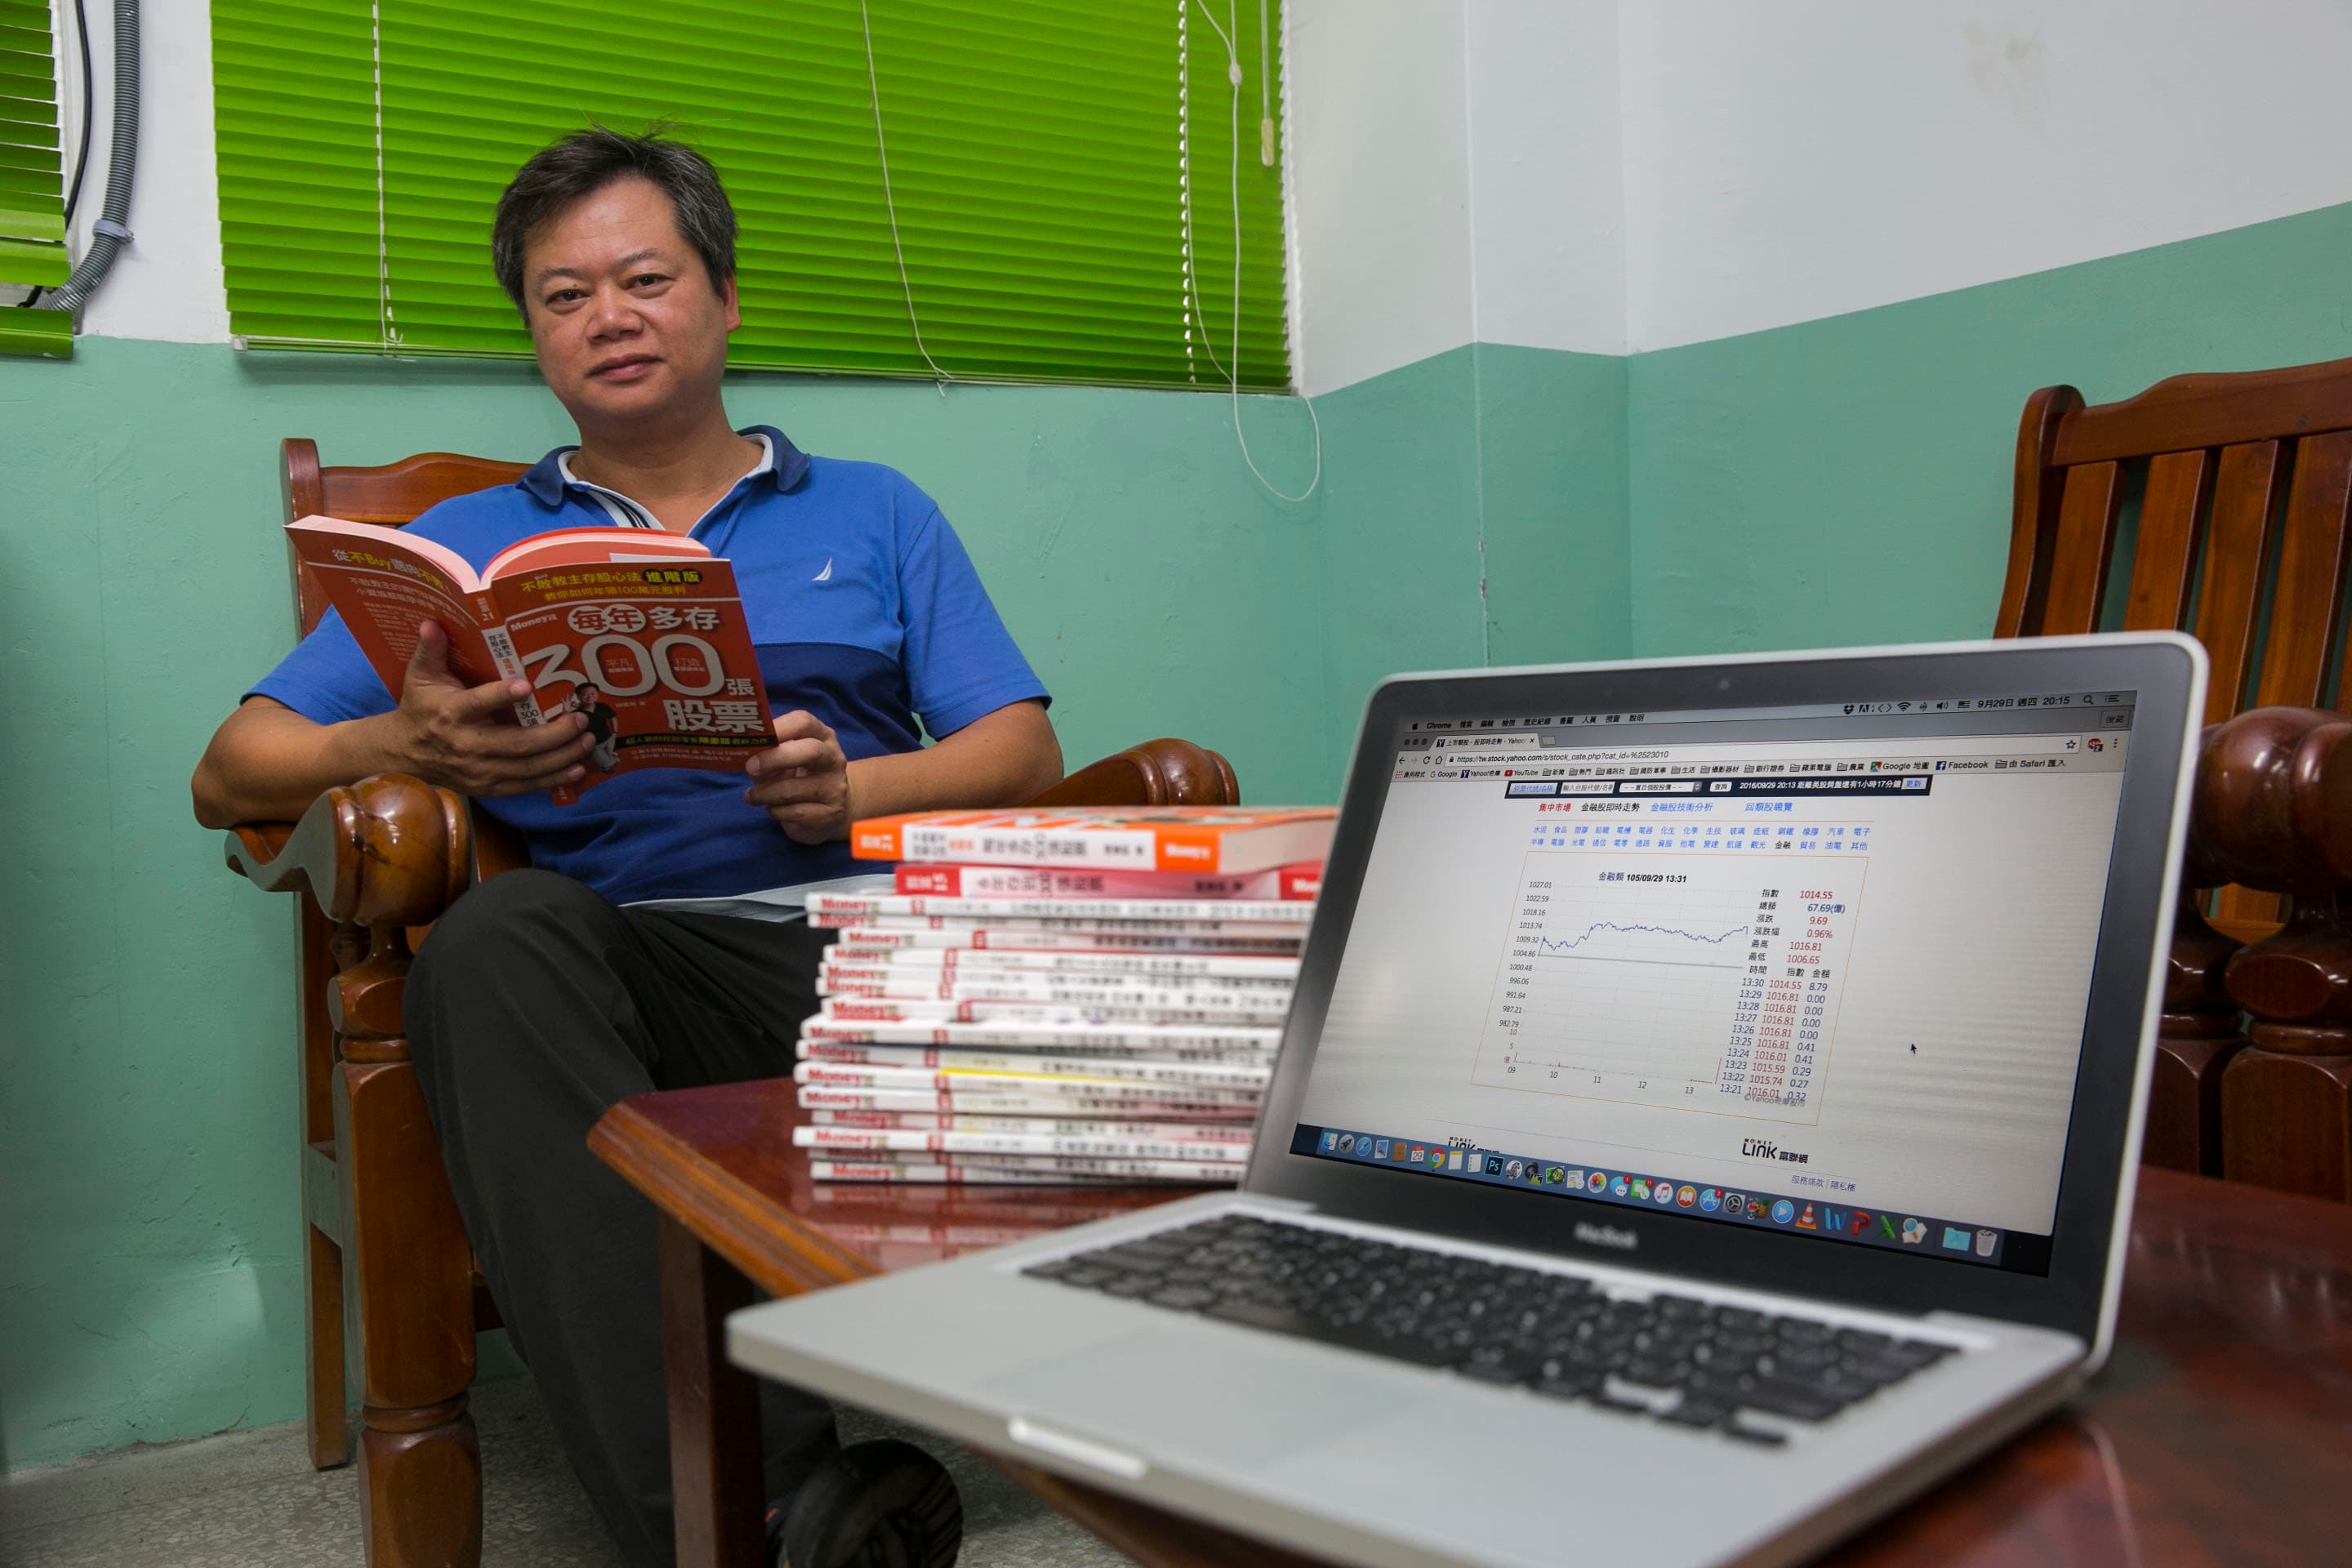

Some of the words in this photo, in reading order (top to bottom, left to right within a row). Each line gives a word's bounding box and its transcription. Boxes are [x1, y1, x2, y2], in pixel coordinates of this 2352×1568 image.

[645, 571, 700, 583] 進階版
[570, 605, 719, 632] 每年多存
[520, 634, 725, 720] 300
[725, 679, 755, 696] 張
[1977, 698, 2014, 709] 9月29日
[2017, 697, 2038, 707] 週四
[2042, 696, 2070, 706] 20:15
[662, 699, 764, 732] 股票
[1882, 763, 1911, 771] Google
[1905, 779, 1921, 787] 更新
[1539, 803, 1571, 812] 集中市場
[1581, 803, 1640, 812] 金融股即時走勢
[1650, 803, 1713, 812] 金融股技術分析
[1828, 827, 1845, 836] 汽車
[1854, 828, 1871, 836] 電子
[1775, 841, 1791, 849] 金融
[1851, 842, 1868, 850] 其他
[1598, 871, 1624, 882] 金融類
[1626, 874, 1663, 883] 105/09/29
[1665, 875, 1686, 883] 13:31
[1762, 889, 1780, 898] 指數
[1800, 890, 1833, 899] 1014.55
[1522, 908, 1545, 916] 1018.16
[1807, 904, 1846, 914] 67.69(億)
[1756, 915, 1774, 923] 漲跌
[1806, 929, 1833, 938] 0.96%
[1751, 939, 1769, 948] 最高
[1790, 942, 1822, 951] 1016.81
[1748, 952, 1766, 961] 最低
[1787, 955, 1820, 964] 1006.65
[1509, 963, 1532, 972] 1000.48
[1749, 966, 1767, 975] 時間
[1787, 968, 1805, 978] 指數
[1812, 969, 1830, 978] 金額
[1742, 978, 1764, 987] 13:30
[1769, 979, 1802, 990] 1014.55
[1809, 982, 1827, 991] 8.79
[1740, 990, 1762, 999] 13:29
[1766, 991, 1799, 1001] 1016.81
[1806, 994, 1825, 1004] 0.00
[1502, 1005, 1522, 1013] 987.21
[1737, 1001, 1759, 1010] 13:28
[1764, 1003, 1797, 1013] 1016.81
[1804, 1006, 1823, 1015] 0.00
[1499, 1019, 1519, 1027] 982.79
[1735, 1013, 1757, 1022] 13:27
[1762, 1015, 1794, 1026] 1016.81
[1802, 1018, 1820, 1027] 0.00
[1732, 1025, 1754, 1035] 13:26
[1759, 1027, 1792, 1037] 1016.81
[1800, 1030, 1818, 1039] 0.00
[1730, 1036, 1752, 1046] 13:25
[1757, 1039, 1789, 1049] 1016.81
[1797, 1043, 1815, 1052] 0.41
[1727, 1049, 1749, 1058] 13:24
[1754, 1051, 1787, 1062] 1016.01
[1795, 1054, 1812, 1064] 0.41
[1725, 1060, 1747, 1070] 13:23
[1753, 1062, 1785, 1073] 1015.59
[1793, 1067, 1811, 1076] 0.29
[1722, 1072, 1744, 1082] 13:22
[1750, 1075, 1783, 1085] 1015.74
[1790, 1079, 1809, 1089] 0.27
[1685, 1086, 1694, 1094] 13
[1720, 1084, 1742, 1094] 13:21
[1747, 1087, 1780, 1098] 1016.01
[1413, 1152, 1422, 1160] 29
[1489, 1160, 1499, 1171] Ps
